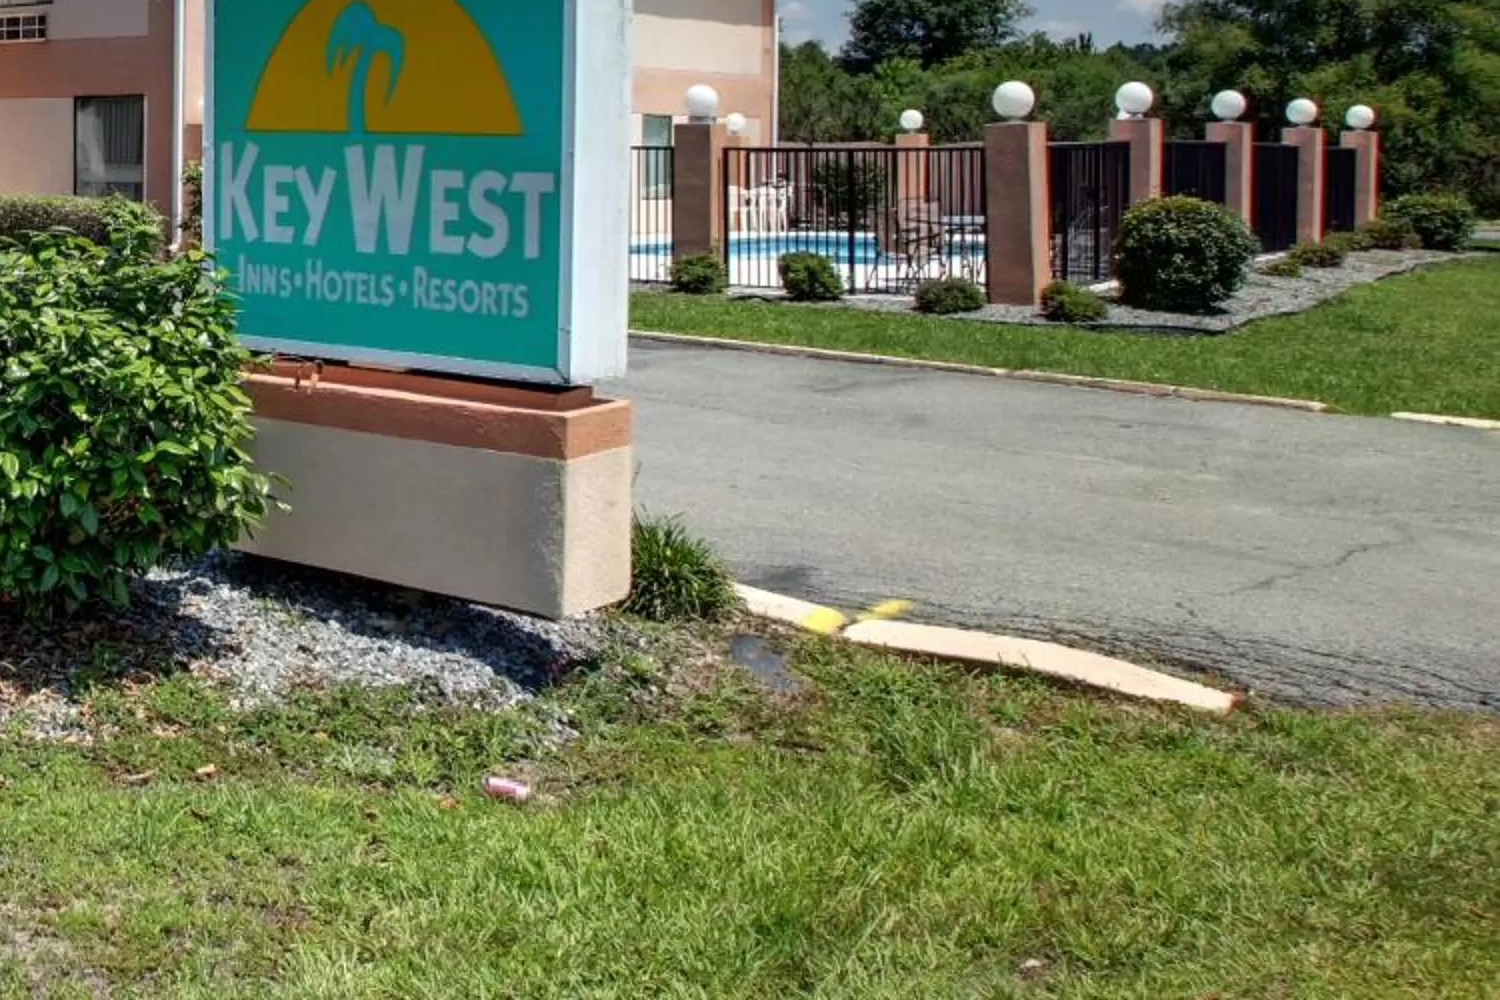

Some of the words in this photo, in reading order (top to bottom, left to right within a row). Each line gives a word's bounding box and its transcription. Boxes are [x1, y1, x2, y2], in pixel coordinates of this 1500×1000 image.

[237, 253, 293, 298] INNS
[305, 256, 394, 307] HOTELS
[412, 265, 530, 319] RESORTS
